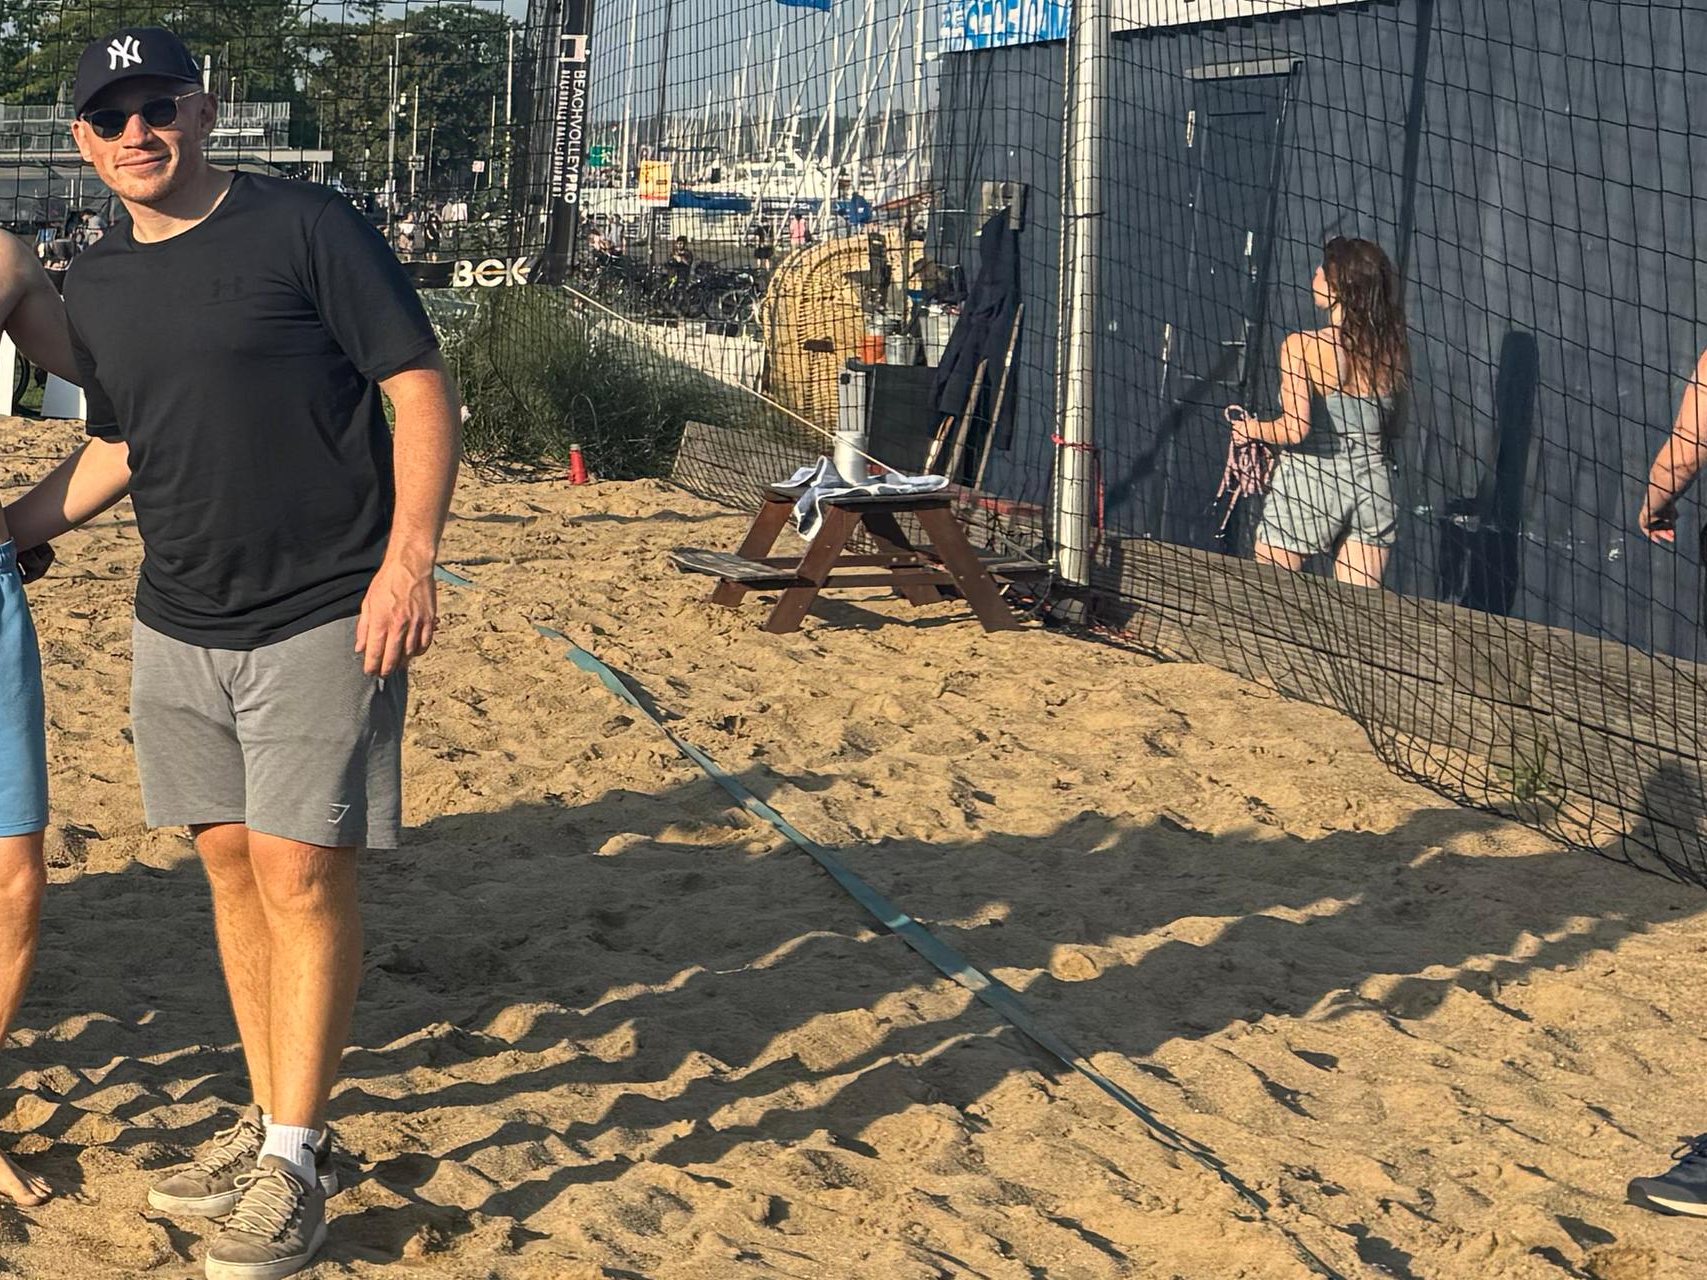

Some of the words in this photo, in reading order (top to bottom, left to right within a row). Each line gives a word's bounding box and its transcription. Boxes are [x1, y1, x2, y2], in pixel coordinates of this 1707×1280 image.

[106, 35, 143, 71] NY
[563, 69, 587, 205] BEACHVOLLEYPRO
[451, 256, 532, 288] BCK
